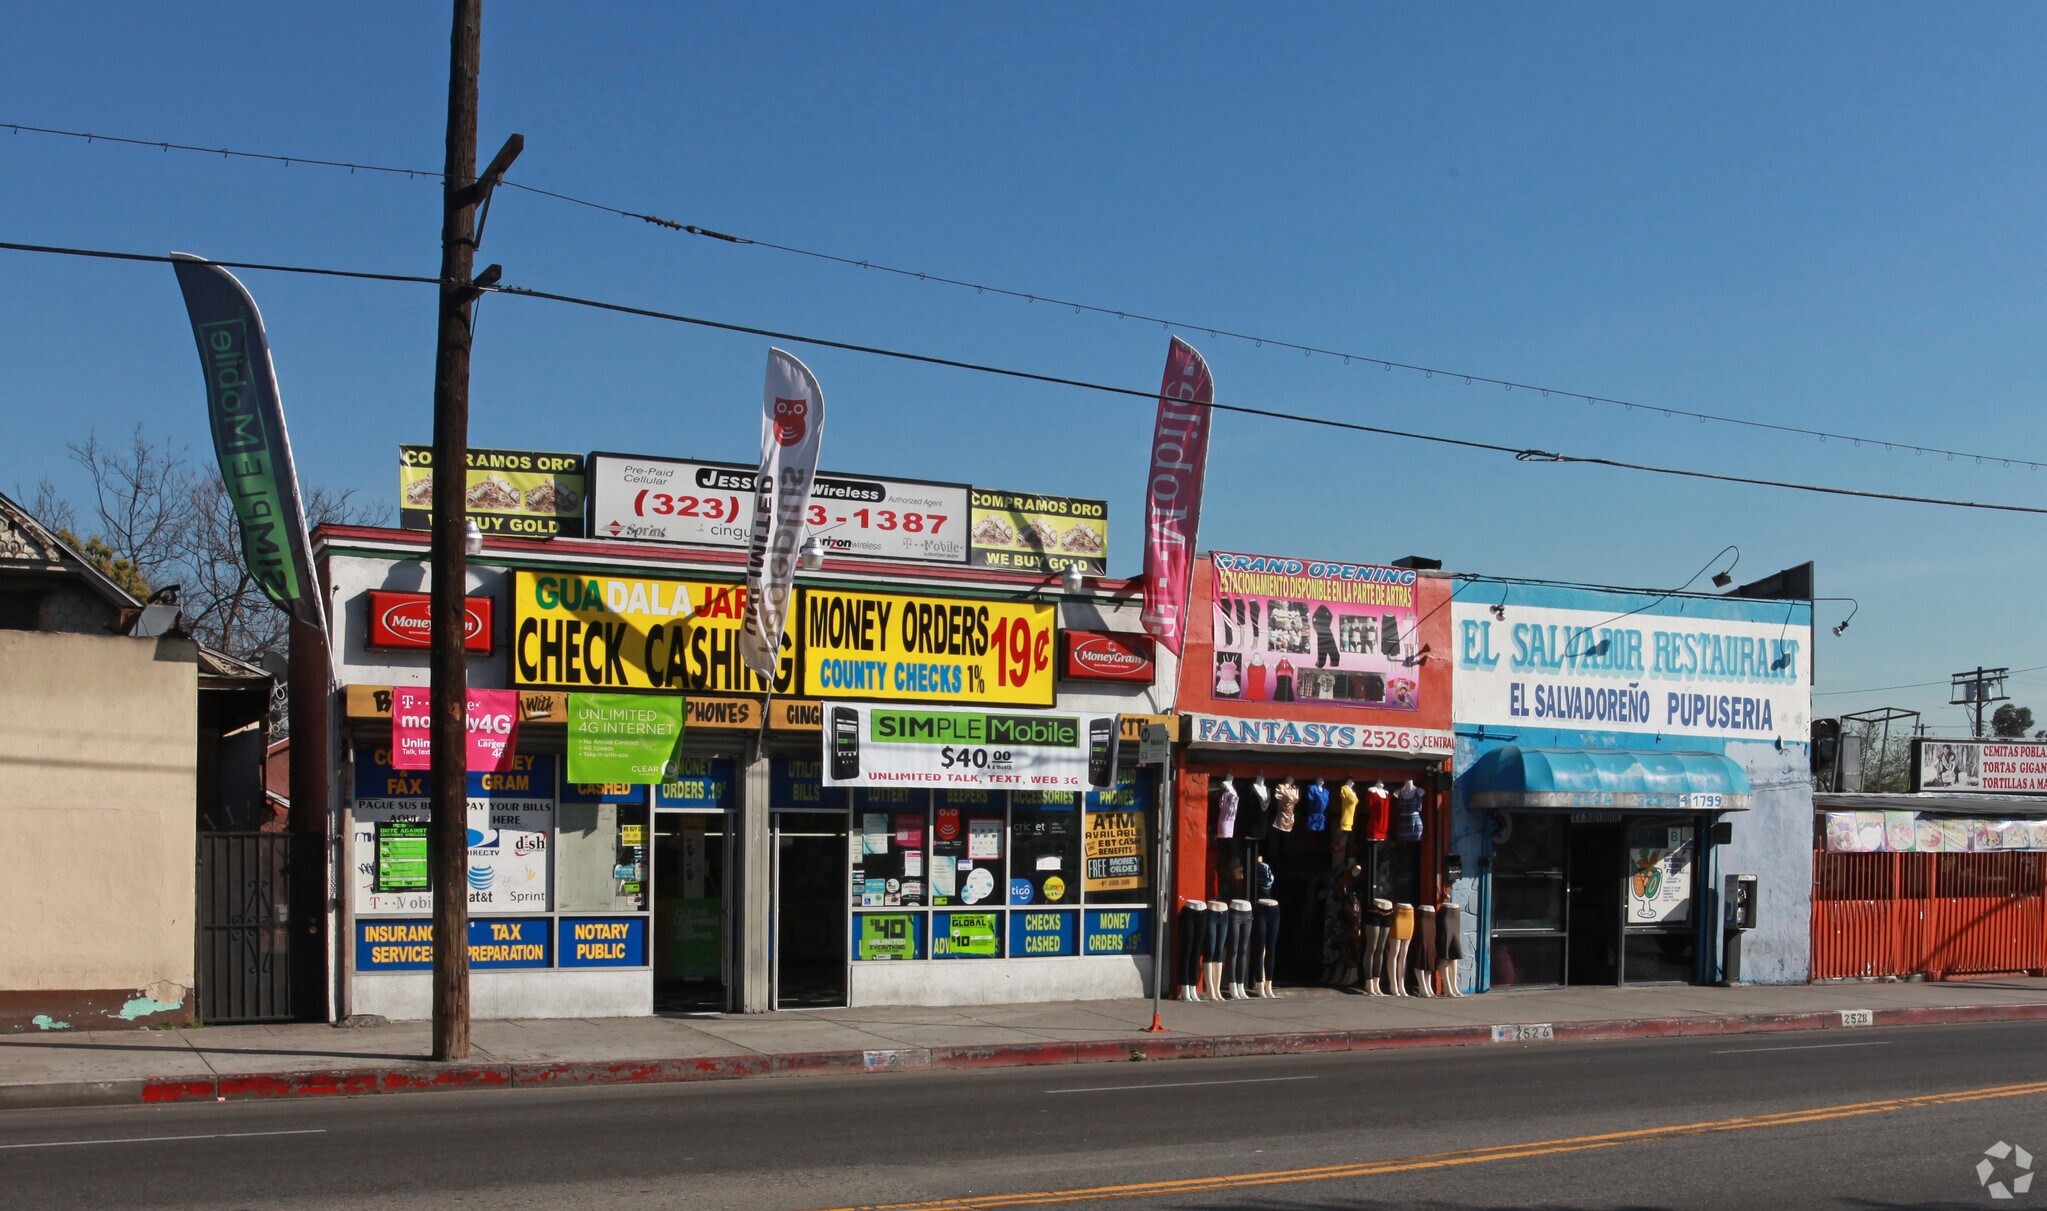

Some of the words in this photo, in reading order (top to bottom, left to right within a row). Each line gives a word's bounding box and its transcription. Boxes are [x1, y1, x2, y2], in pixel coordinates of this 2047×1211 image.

[407, 450, 531, 469] CORAMOS
[537, 457, 576, 471] ORO
[623, 474, 668, 486] Cellular
[624, 465, 674, 478] Pre-Paid
[702, 470, 757, 490] JESS
[812, 483, 879, 500] Wireless
[888, 495, 922, 506] Authorized
[923, 499, 943, 508] Agent
[972, 494, 1068, 515] COMPRAMOS
[1072, 503, 1102, 517] ORO
[634, 489, 740, 524] (323)
[806, 504, 948, 534] 3-1387
[510, 519, 560, 534] GOLD
[627, 523, 667, 538] Sprint
[710, 524, 752, 541] cingu
[852, 541, 882, 551] wireless
[987, 552, 1009, 566] WE
[1014, 555, 1043, 568] BUY
[1049, 558, 1088, 572] GOD
[1214, 553, 1303, 575] GRAND
[1308, 562, 1417, 586] OPENING
[1219, 570, 1288, 598] ESTACIONAMIENTO
[1290, 577, 1332, 602] DISPONIBLE
[1332, 581, 1342, 603] EN
[1342, 582, 1352, 604] LA
[1353, 583, 1375, 606] PARTE
[1375, 585, 1386, 606] DE
[1385, 586, 1412, 608] ARTRAS
[810, 596, 892, 652] MONEY
[902, 601, 989, 657] ORDERS
[517, 616, 629, 686] CHECK
[1081, 650, 1142, 664] MoneyGram
[1460, 619, 1500, 673] EL
[1510, 623, 1645, 688] SALVADOR
[1650, 630, 1800, 686] RESTAURANT
[820, 658, 887, 690] COUNTY
[894, 661, 962, 694] CHECKS
[967, 664, 985, 694] 1%
[687, 702, 749, 723] PHONES
[786, 704, 823, 725] CING
[1510, 682, 1530, 717] EL
[1534, 681, 1650, 724] SALVADOREÑO
[1667, 692, 1773, 731] PUPUSERIA
[579, 708, 657, 722] UNLIMITED
[402, 714, 511, 735] moly4G
[579, 721, 599, 734] 4G
[603, 722, 673, 735] INTERNET
[879, 716, 982, 739] SIMPLE
[991, 717, 1074, 744] Mobile
[1200, 718, 1356, 748] FANTASYS
[1361, 728, 1411, 750] 2526
[1423, 736, 1456, 750] CENTRAL
[1983, 745, 2018, 758] CEMITAS
[2020, 746, 2047, 758] POBLA
[631, 764, 659, 774] CLEAR
[787, 760, 823, 778] UTILIT
[1982, 761, 2016, 774] TORTAS
[2019, 763, 2047, 774] GIGAN
[387, 778, 422, 795] FAX
[481, 773, 529, 791] GRAM
[868, 772, 942, 781] UNLIMITED
[947, 774, 983, 785] TALK,
[988, 774, 1026, 785] TEXT,
[1031, 776, 1059, 784] WEB
[1063, 777, 1079, 785] 3G
[1982, 777, 2027, 790] TORTILLAS
[2028, 778, 2035, 789] A
[577, 781, 631, 796] CASHED
[662, 780, 704, 799] ORDERS
[792, 783, 821, 801] BILLS
[359, 801, 395, 810] PAGUE
[398, 801, 417, 810] SUS
[1100, 789, 1135, 806] PHONES
[1692, 795, 1723, 807] 1799
[489, 802, 520, 812] YOUR
[523, 803, 552, 812] BILLS
[492, 815, 521, 825] HERE
[1093, 812, 1136, 831] ATM
[516, 834, 546, 850] dish
[1086, 829, 1143, 840] AVAILABLE
[1098, 840, 1117, 848] EBT
[1118, 838, 1142, 847] CASH
[1670, 831, 1679, 842] B
[1099, 847, 1133, 856] BENEFITS
[1088, 858, 1107, 879] FREE
[1109, 857, 1140, 866] MONEY
[1109, 864, 1140, 874] ORDER
[469, 891, 493, 903] at&t
[510, 891, 546, 903] Sprint
[951, 919, 986, 927] GLOBAL
[1025, 914, 1061, 931] CHECKS
[1100, 912, 1131, 929] MONEY
[365, 925, 433, 942] INSURAN
[491, 924, 522, 940] TAX
[575, 923, 630, 940] NOTARY
[577, 942, 626, 960] PUBLIC
[1025, 936, 1061, 953] CASHED
[1089, 934, 1124, 951] ORDERS
[371, 945, 433, 963] SERVICE
